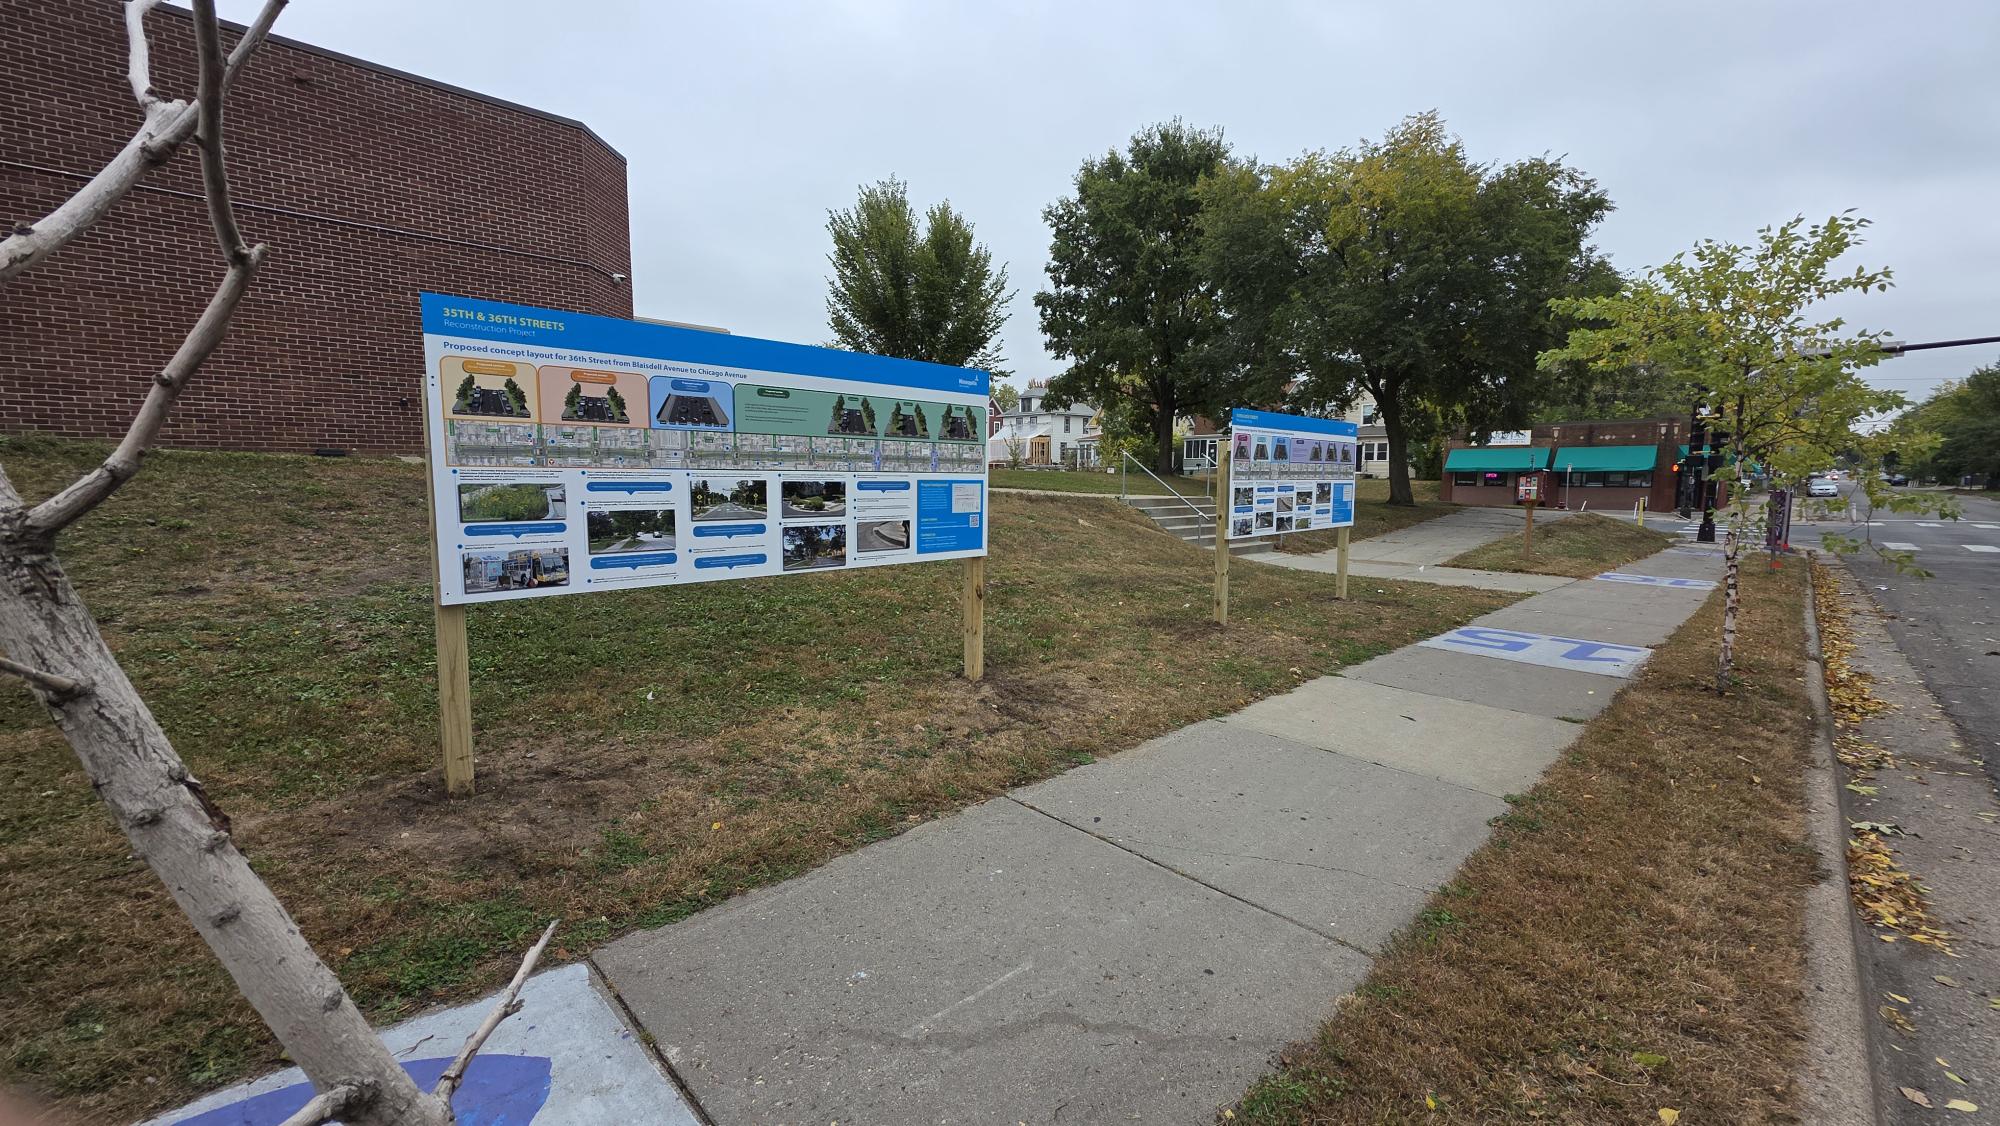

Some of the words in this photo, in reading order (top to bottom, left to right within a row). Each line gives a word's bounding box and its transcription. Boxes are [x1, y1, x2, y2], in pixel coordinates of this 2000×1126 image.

[442, 307, 474, 320] 35TH
[476, 313, 486, 322] &
[488, 313, 517, 325] 36TH
[519, 317, 565, 331] STREETS
[443, 319, 507, 334] Reconstruction
[508, 326, 536, 339] Project
[443, 341, 488, 354] Proposed
[490, 347, 525, 358] concept
[526, 350, 554, 360] layout
[555, 353, 567, 361] for
[568, 354, 587, 363] 36th
[588, 355, 612, 366] Street
[613, 358, 631, 367] from
[632, 361, 662, 370] Blaisdell
[663, 364, 689, 373] Avenue
[698, 368, 724, 378] Chicago
[724, 370, 748, 379] Avenue
